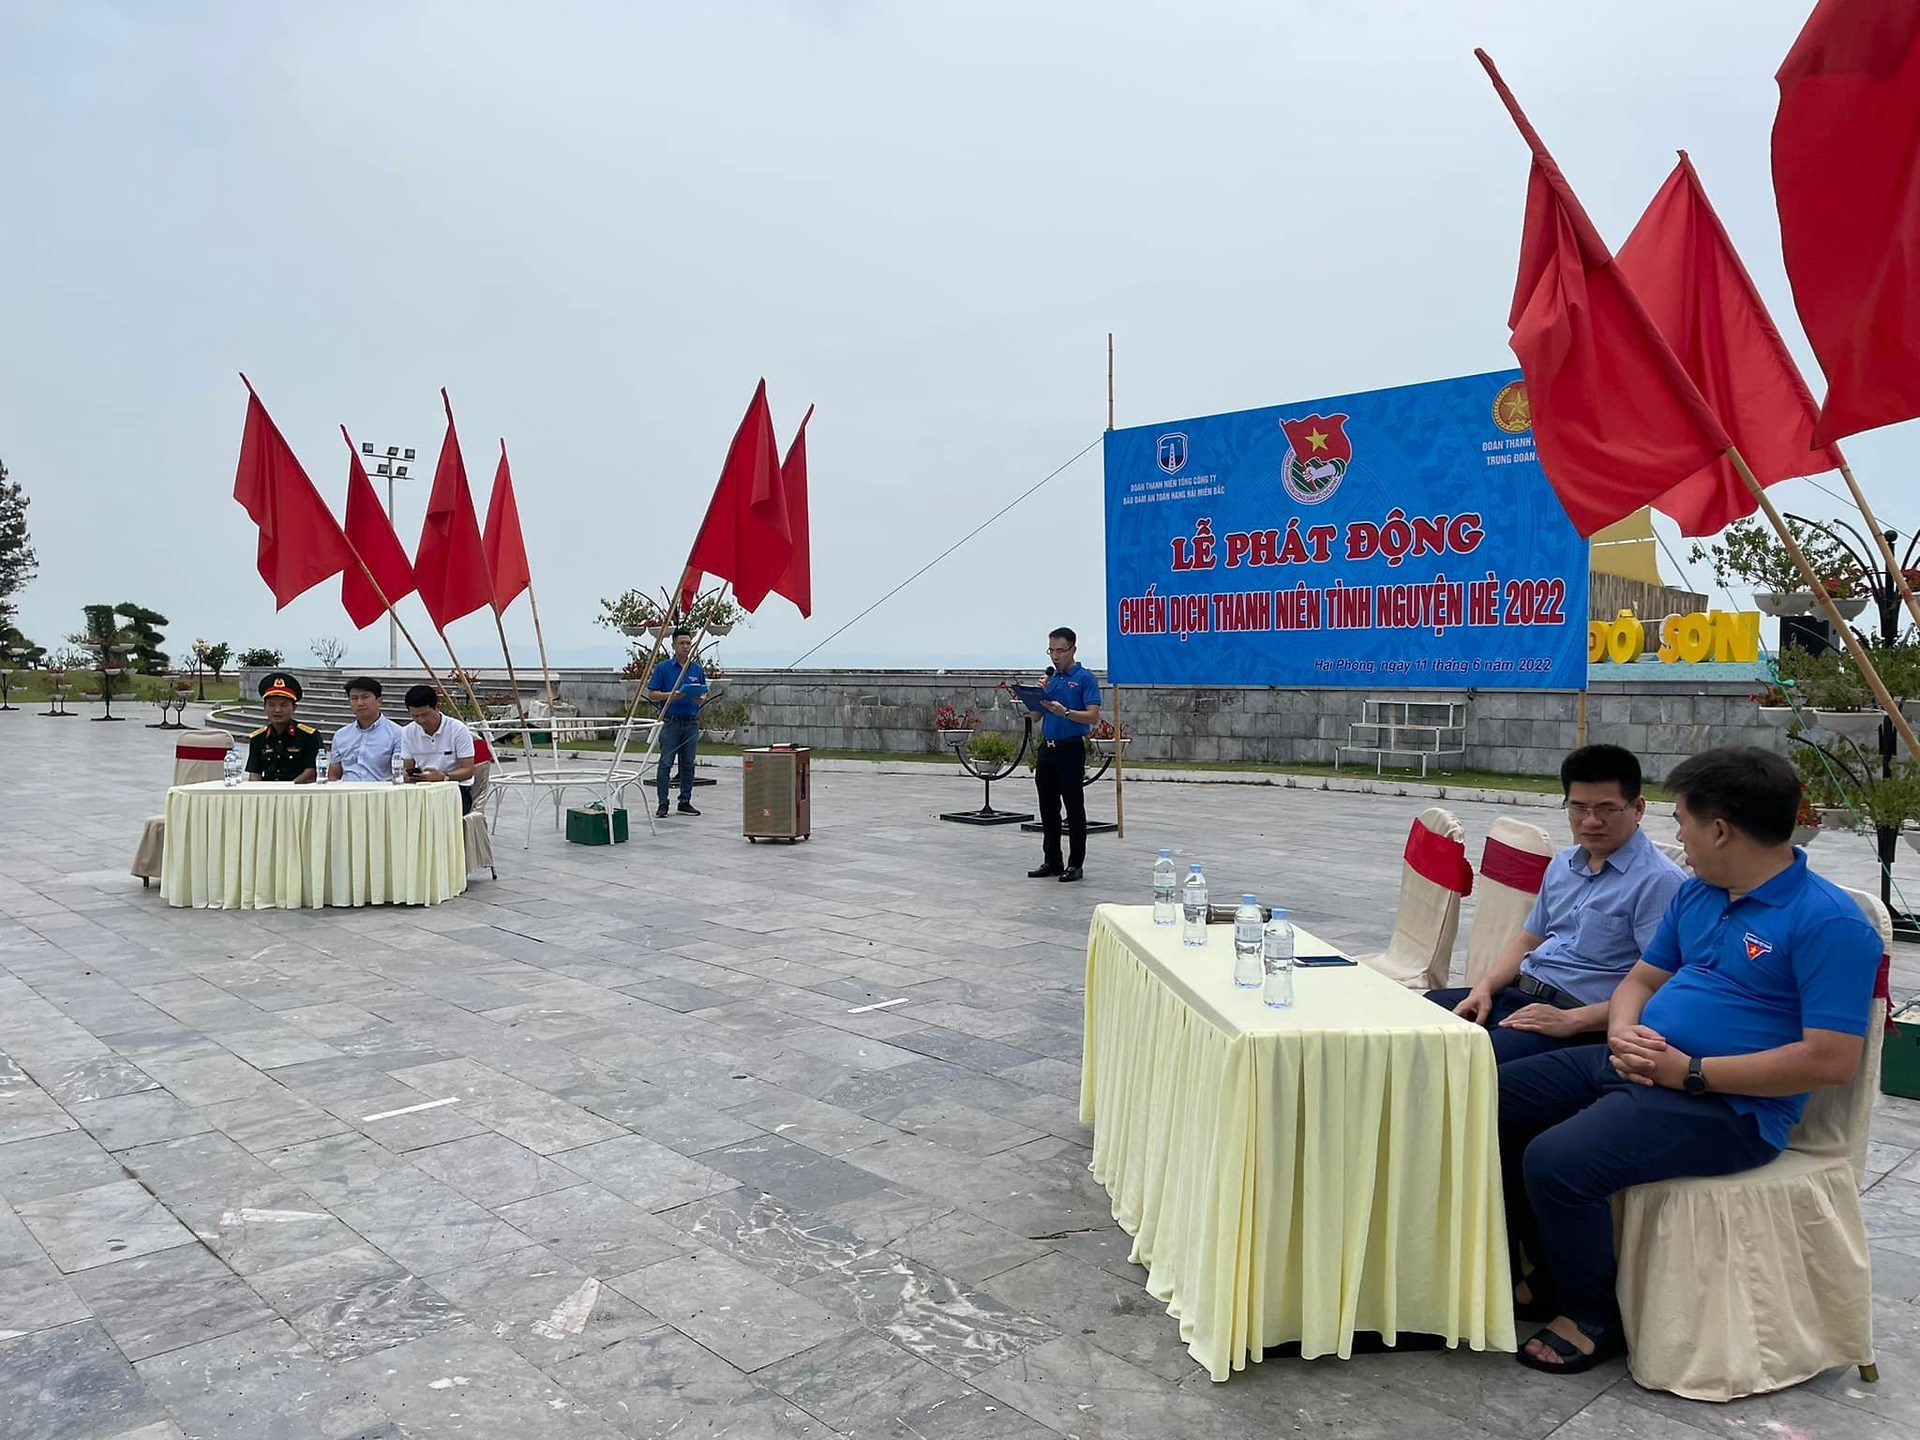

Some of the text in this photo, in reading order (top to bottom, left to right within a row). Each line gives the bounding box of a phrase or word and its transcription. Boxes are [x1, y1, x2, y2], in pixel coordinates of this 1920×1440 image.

[1505, 437, 1532, 449] THANH
[1486, 454, 1512, 466] TRUNG
[1171, 508, 1485, 571] LỄ PHÁT ĐỘNG
[1118, 571, 1566, 641] CHIẾN DỊCH THANH NIÊN TÌNH NGUYỆN HÈ 2022
[1415, 658, 1427, 671] 11
[1432, 658, 1469, 675] tháng
[1472, 657, 1482, 672] 6
[1484, 657, 1514, 672] năm
[1518, 658, 1552, 673] 2022
